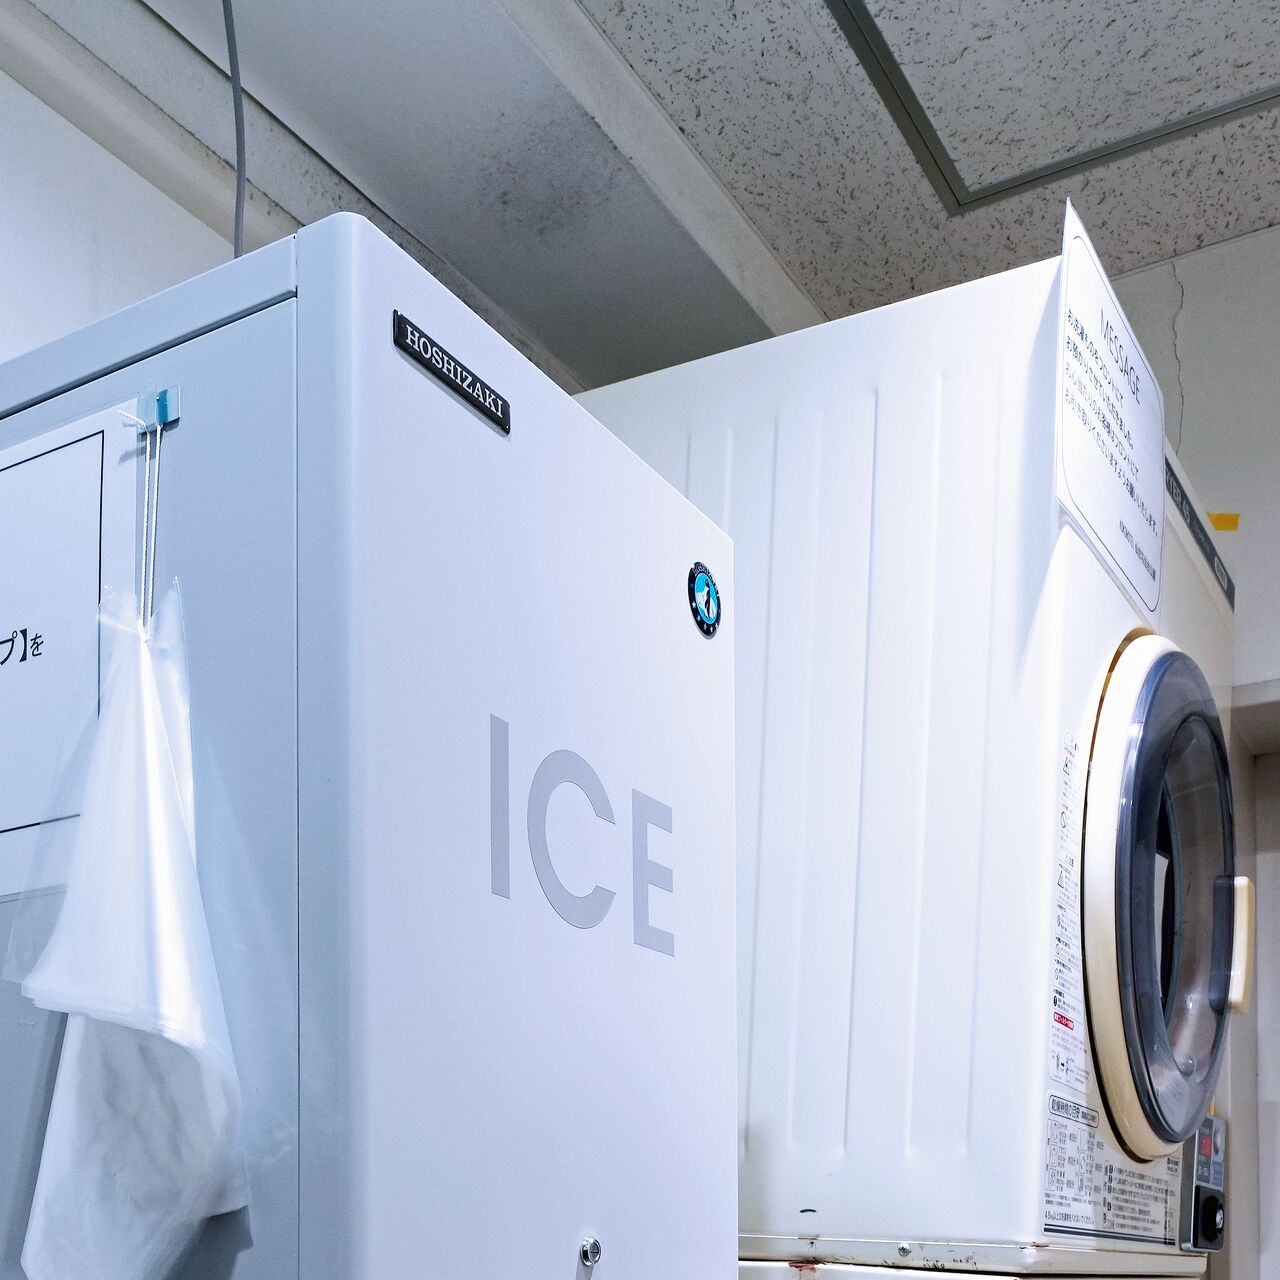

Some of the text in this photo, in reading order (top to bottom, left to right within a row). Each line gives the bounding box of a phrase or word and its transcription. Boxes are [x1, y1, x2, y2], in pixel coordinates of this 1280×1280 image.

[405, 324, 504, 418] HOSHIZAKI
[1100, 308, 1141, 405] MESSAGE
[490, 713, 674, 957] ICE
